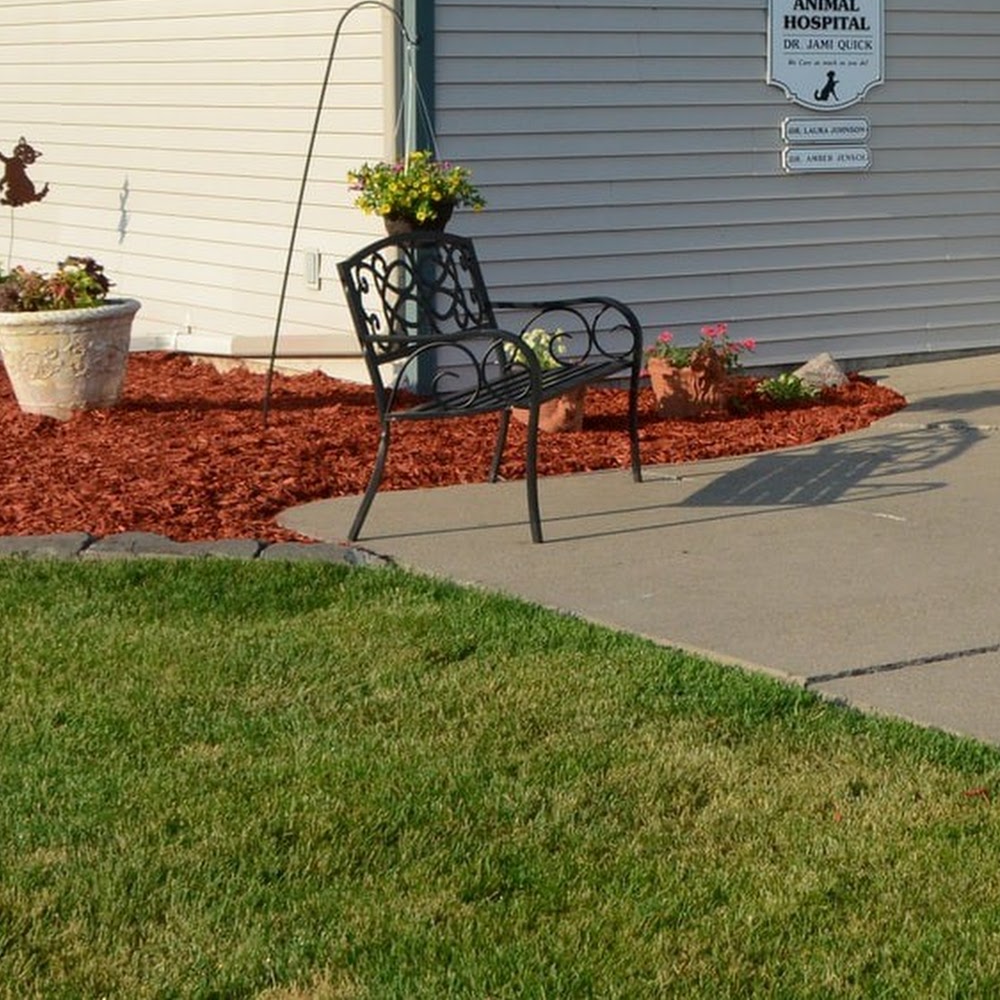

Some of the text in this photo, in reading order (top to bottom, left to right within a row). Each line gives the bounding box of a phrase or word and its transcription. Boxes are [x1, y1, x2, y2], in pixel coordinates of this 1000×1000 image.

[783, 15, 871, 31] HOSPITAL
[806, 39, 834, 51] JAMI
[837, 39, 873, 52] QUICK
